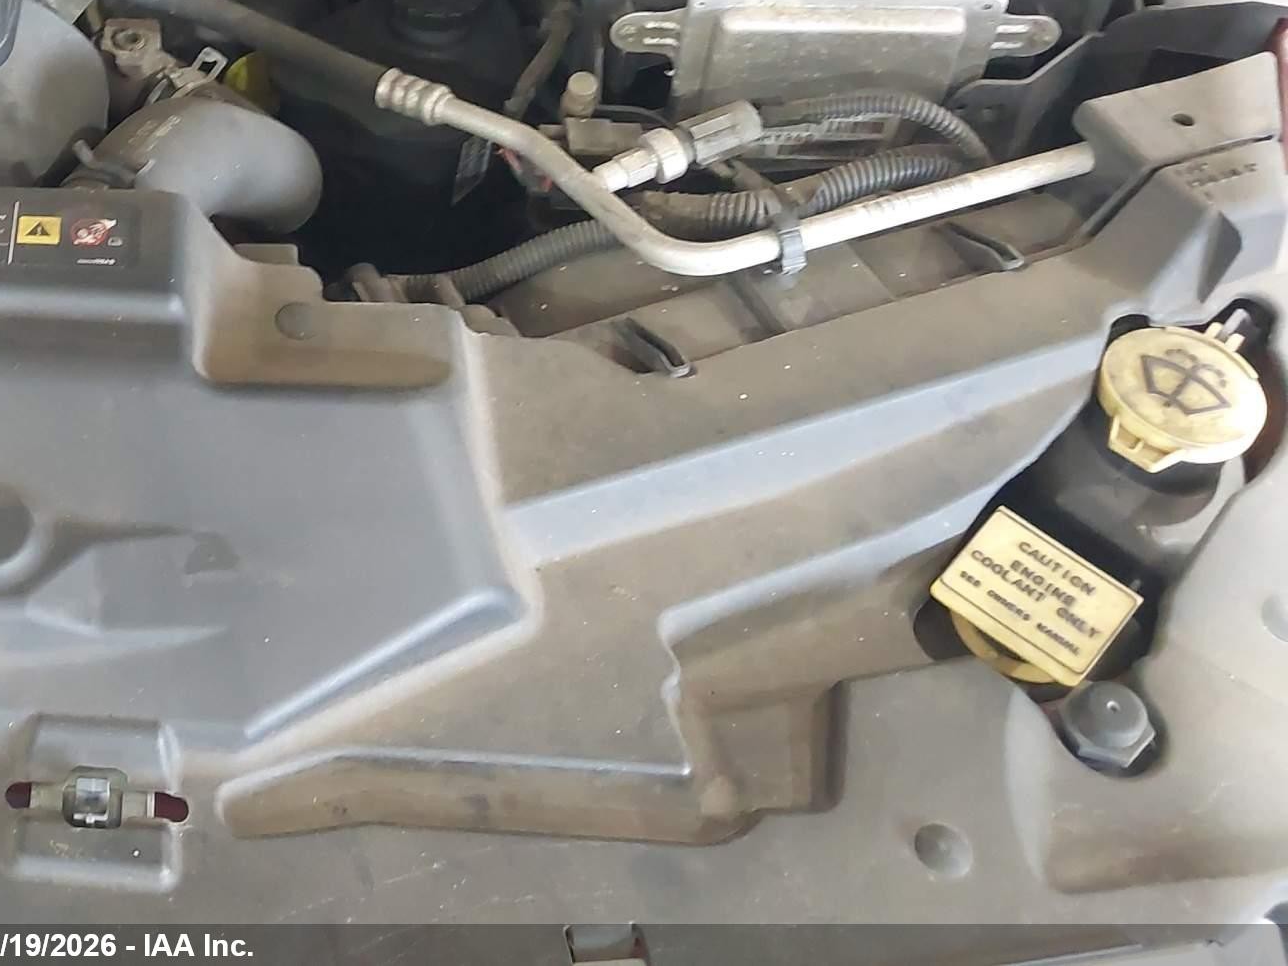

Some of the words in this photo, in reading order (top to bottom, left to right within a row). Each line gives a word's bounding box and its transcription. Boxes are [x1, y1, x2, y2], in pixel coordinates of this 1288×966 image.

[970, 549, 1046, 602] COOLANT
[1056, 607, 1101, 638] ONLY
[1009, 560, 1078, 605] ENGINE
[1018, 541, 1096, 596] CAUTION
[960, 570, 982, 587] SEE
[987, 589, 1031, 622] OWNERS
[1036, 622, 1080, 656] MANUAL
